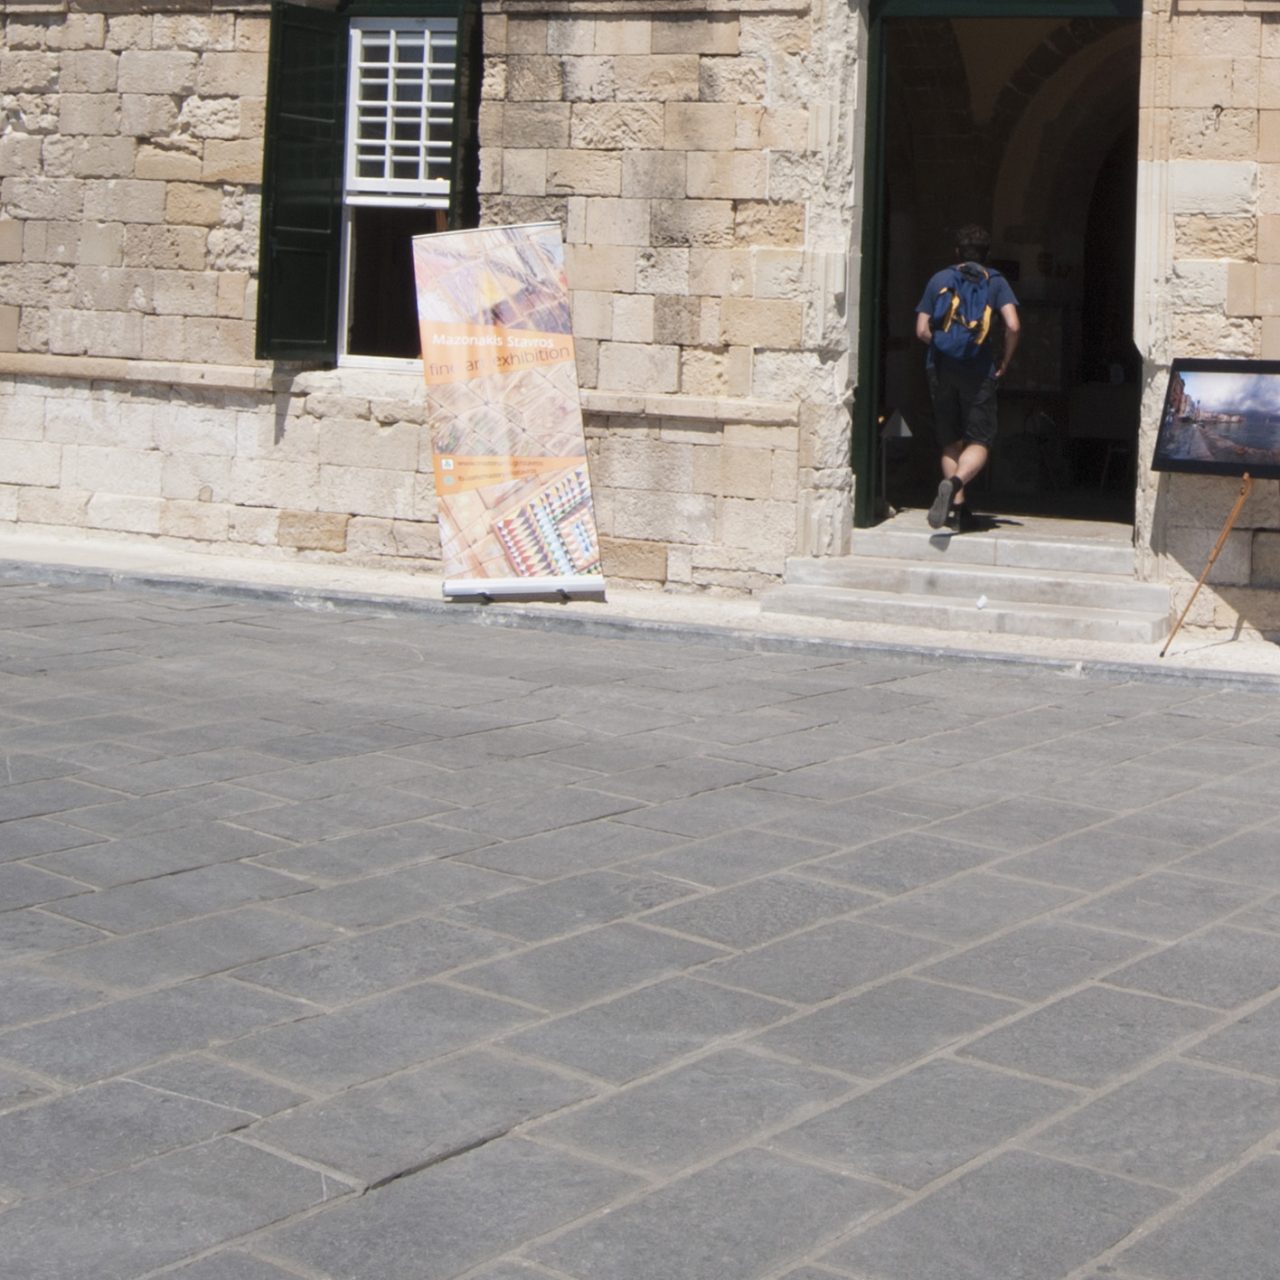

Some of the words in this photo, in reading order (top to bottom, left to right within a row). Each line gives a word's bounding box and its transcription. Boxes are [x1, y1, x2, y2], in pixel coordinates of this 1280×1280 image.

[432, 333, 503, 346] Mazonakis
[507, 335, 554, 348] Stavros
[465, 359, 485, 372] ar
[496, 346, 570, 368] exhibition
